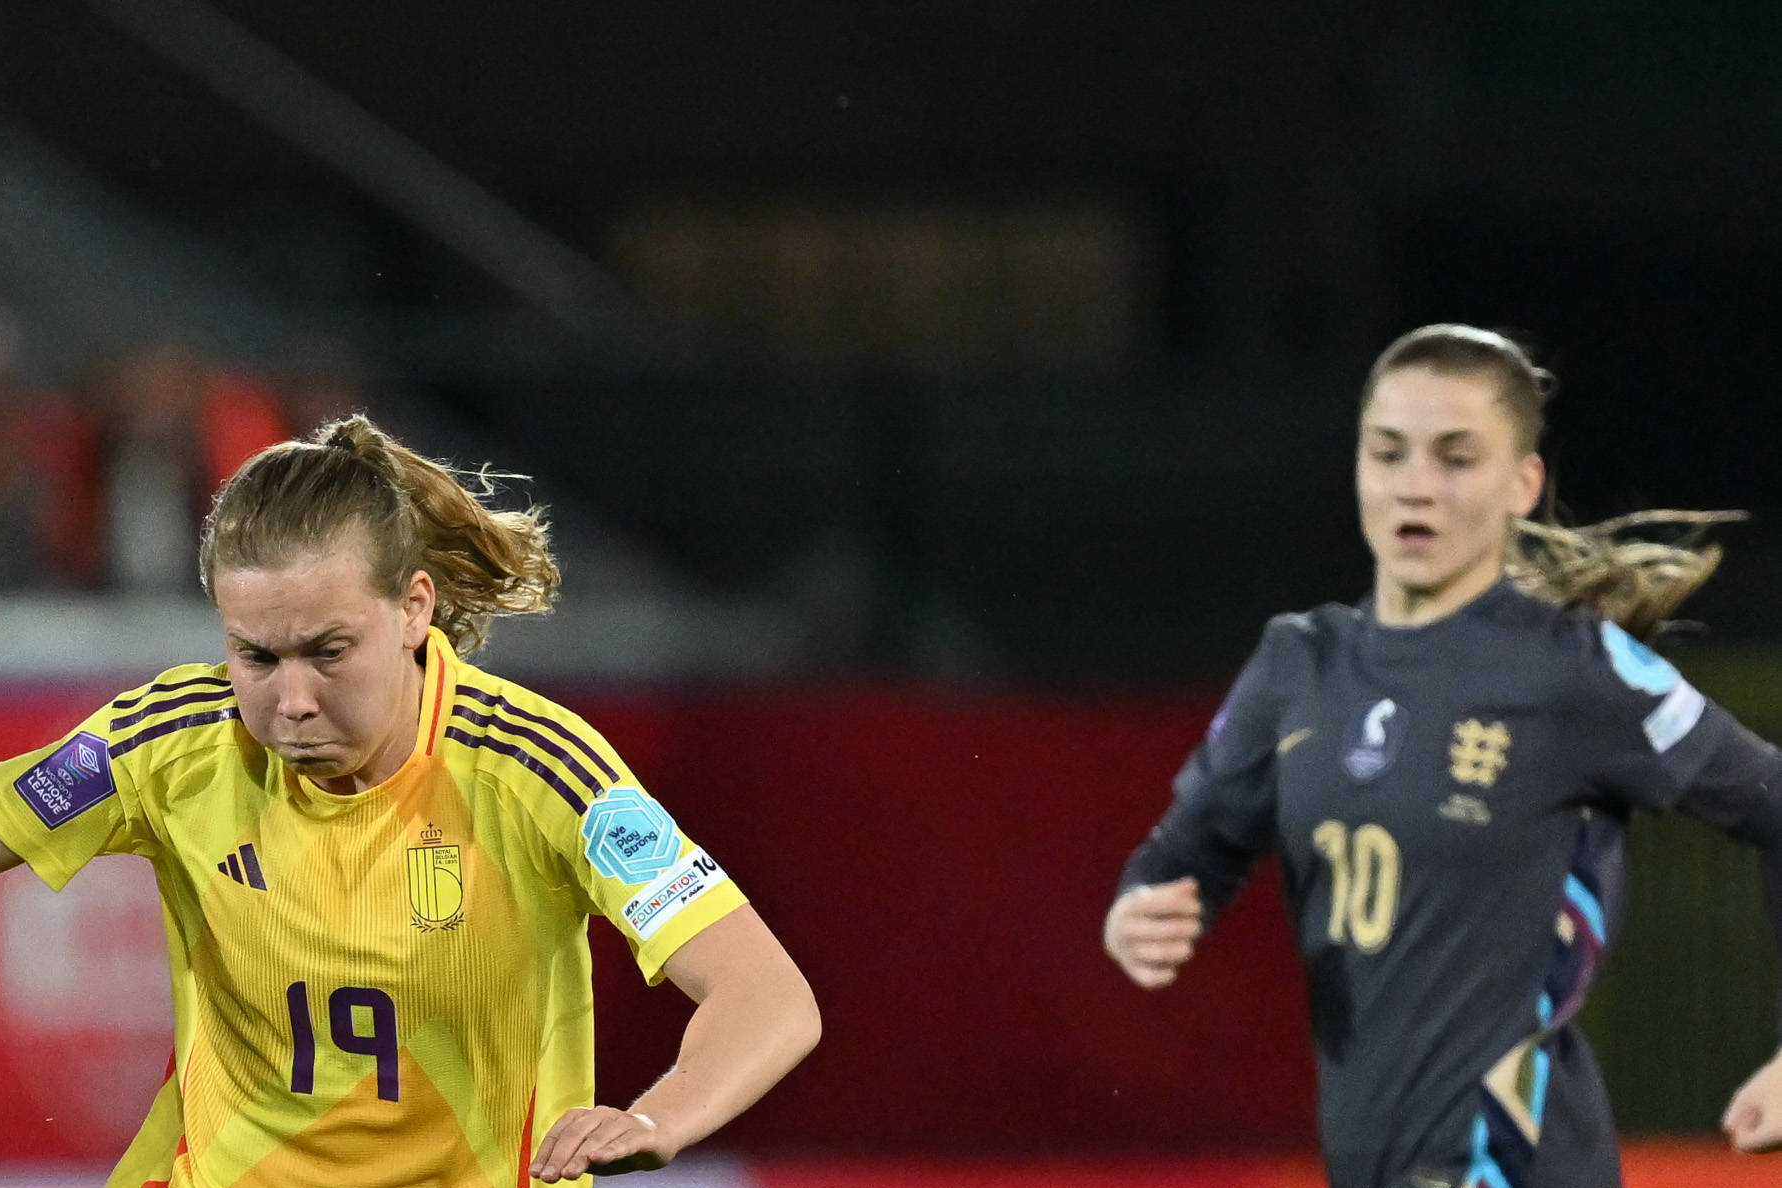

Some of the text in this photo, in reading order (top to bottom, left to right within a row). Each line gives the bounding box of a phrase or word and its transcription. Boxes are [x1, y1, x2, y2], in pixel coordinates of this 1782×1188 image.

[27, 775, 63, 815] LEAGUE
[33, 767, 72, 811] NATIONS
[608, 825, 627, 840] We
[616, 830, 641, 850] Play
[623, 830, 658, 858] Strong
[631, 871, 698, 928] FOUNDATION
[1312, 819, 1401, 955] 10
[287, 981, 400, 1102] 19
